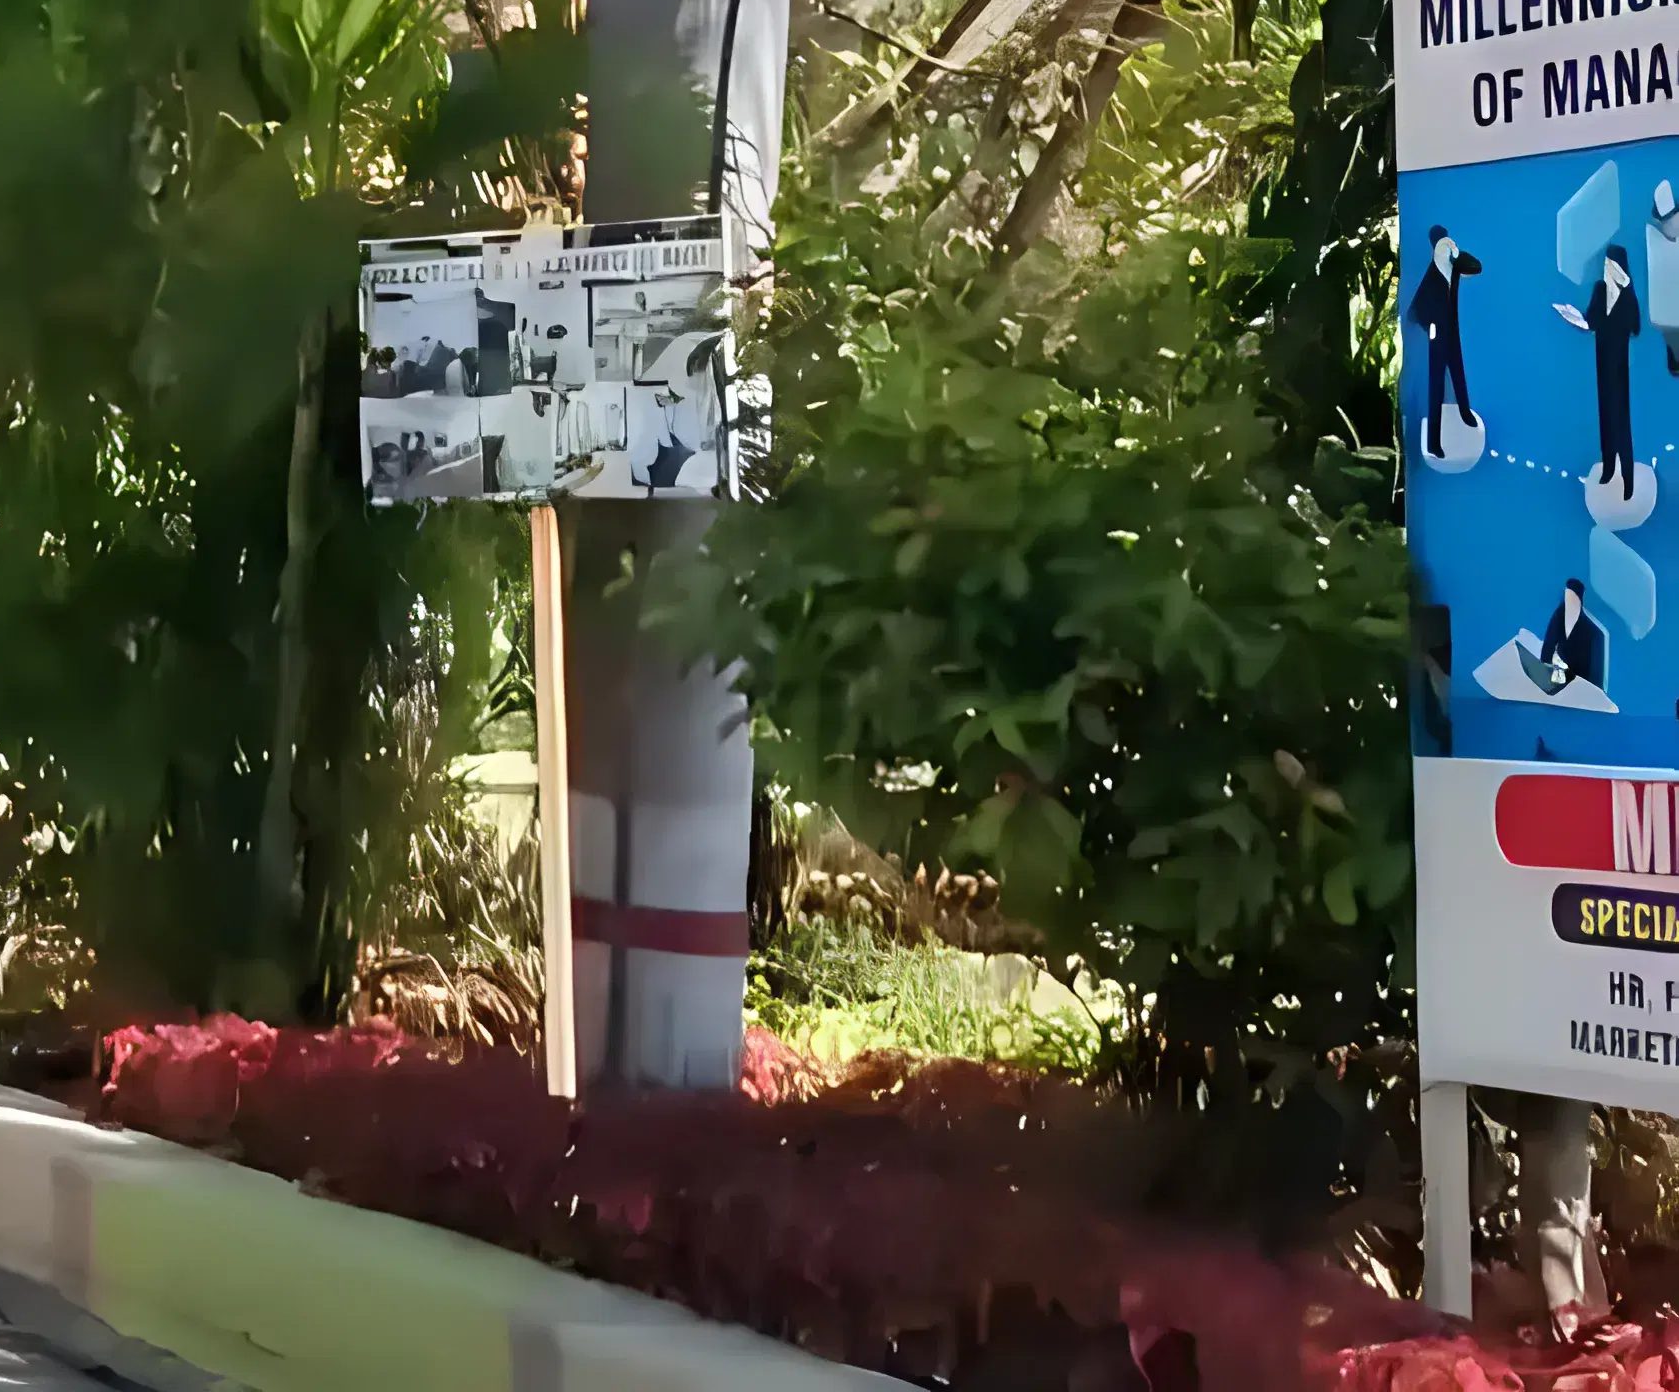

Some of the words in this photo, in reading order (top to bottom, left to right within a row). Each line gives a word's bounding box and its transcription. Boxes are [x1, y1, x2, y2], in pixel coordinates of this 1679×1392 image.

[1472, 68, 1524, 127] OF
[1543, 42, 1679, 118] MANA
[1611, 779, 1679, 875] M
